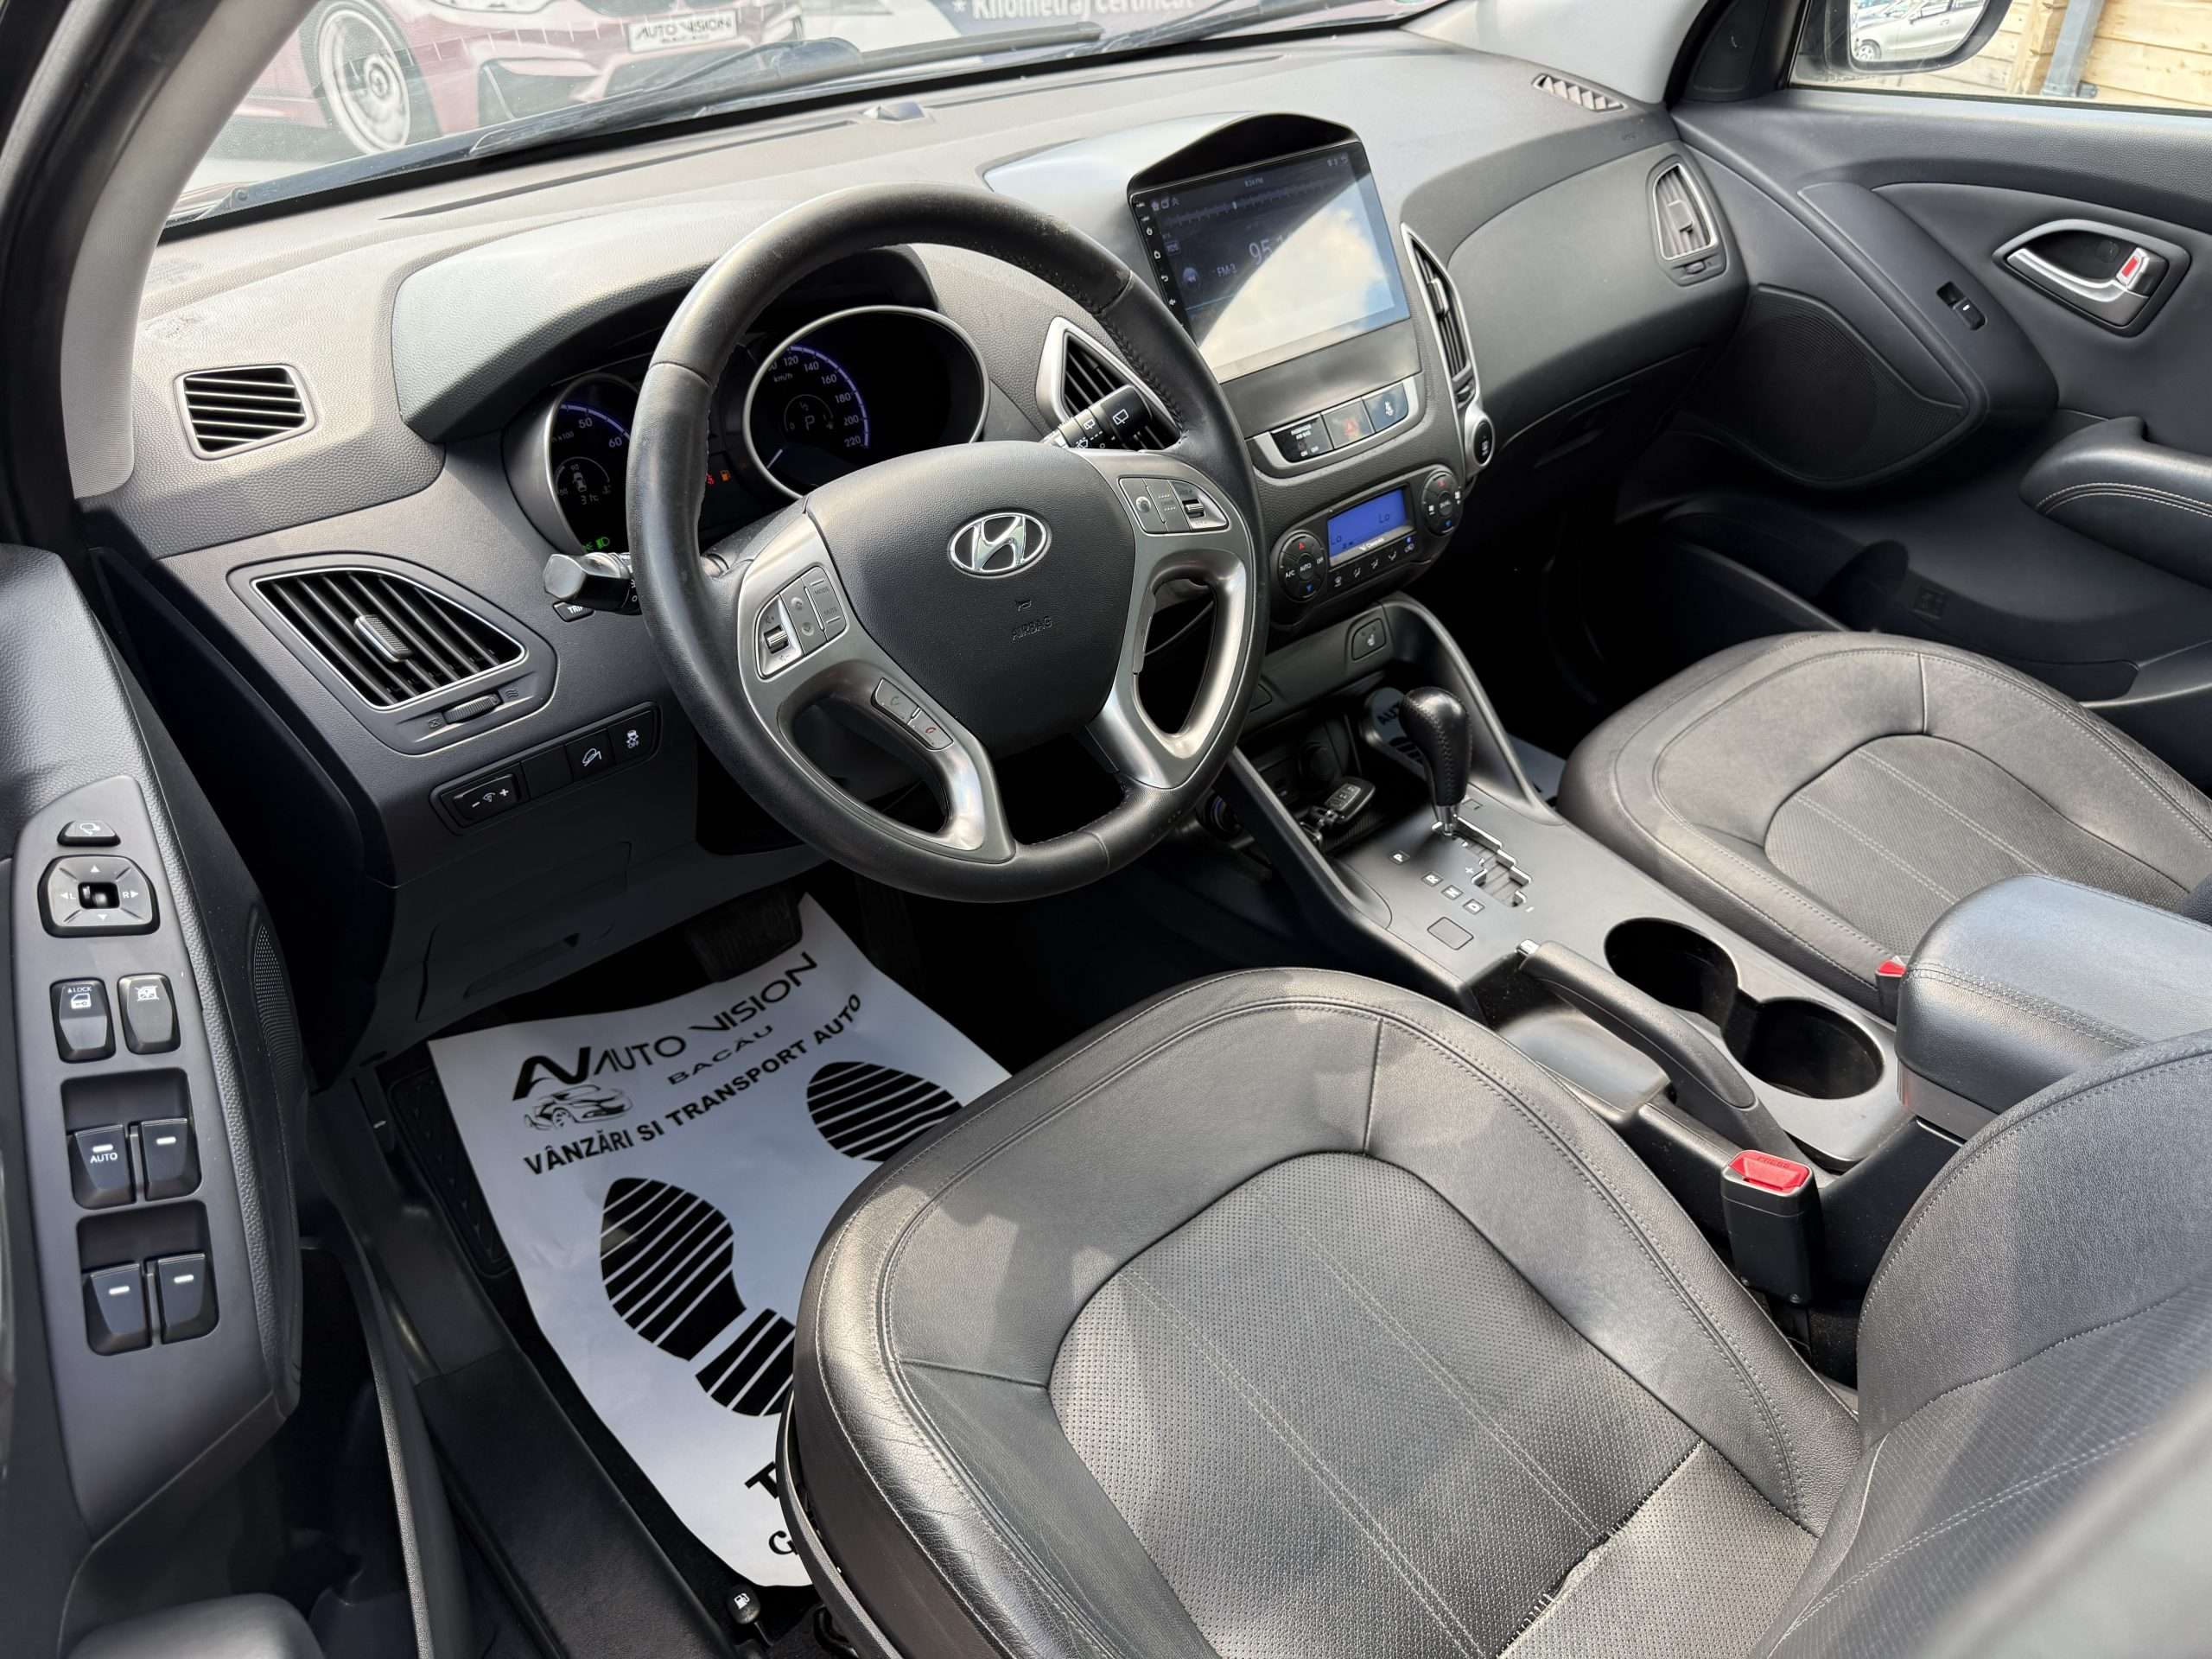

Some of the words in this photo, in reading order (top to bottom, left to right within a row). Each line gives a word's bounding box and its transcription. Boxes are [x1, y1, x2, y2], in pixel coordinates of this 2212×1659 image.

[783, 355, 799, 366] 120
[804, 360, 820, 372] 140
[820, 373, 837, 385] 160
[835, 391, 851, 404] 180
[578, 417, 594, 429] 50
[843, 414, 860, 426] 200
[608, 436, 623, 448] 60
[843, 435, 861, 448] 220
[1285, 569, 1296, 580] A/C
[1393, 853, 1403, 863] P
[1425, 874, 1439, 885] R
[123, 891, 130, 899] R
[594, 1035, 687, 1076] AUTO
[688, 951, 817, 1031] VISION
[523, 1128, 635, 1175] VÂNZĂRI
[637, 1120, 665, 1142] SI
[664, 1039, 808, 1127] TRANSPORT
[812, 994, 861, 1045] AUTO
[90, 1151, 118, 1164] AUTO
